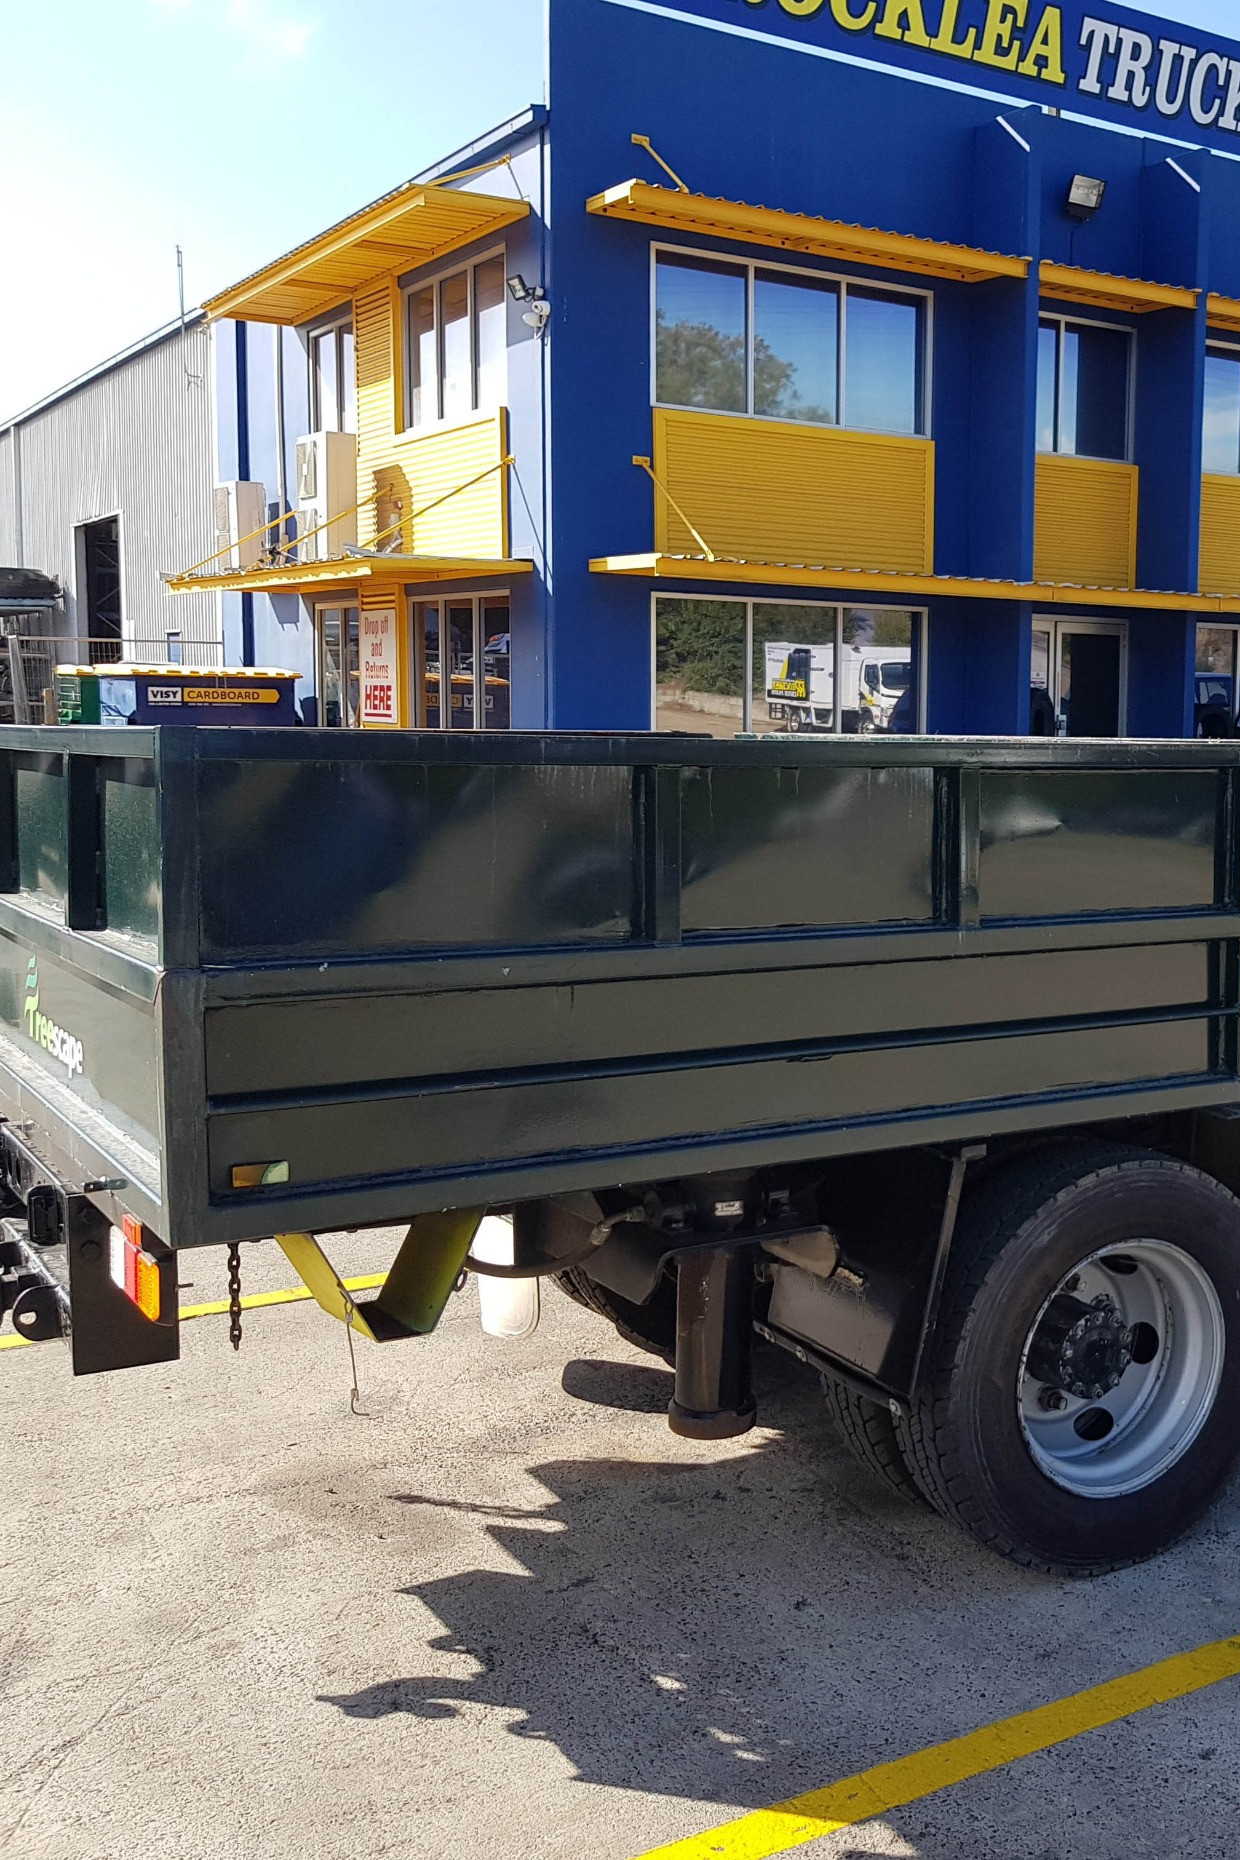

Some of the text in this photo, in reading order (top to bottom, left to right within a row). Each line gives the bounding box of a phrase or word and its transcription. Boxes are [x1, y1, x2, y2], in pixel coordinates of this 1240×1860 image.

[364, 616, 389, 638] Drop off
[371, 639, 383, 657] and
[365, 661, 389, 679] Returns
[151, 690, 260, 700] VISY CARDBOARD
[364, 685, 392, 710] HERE
[25, 994, 84, 1079] Treescape
